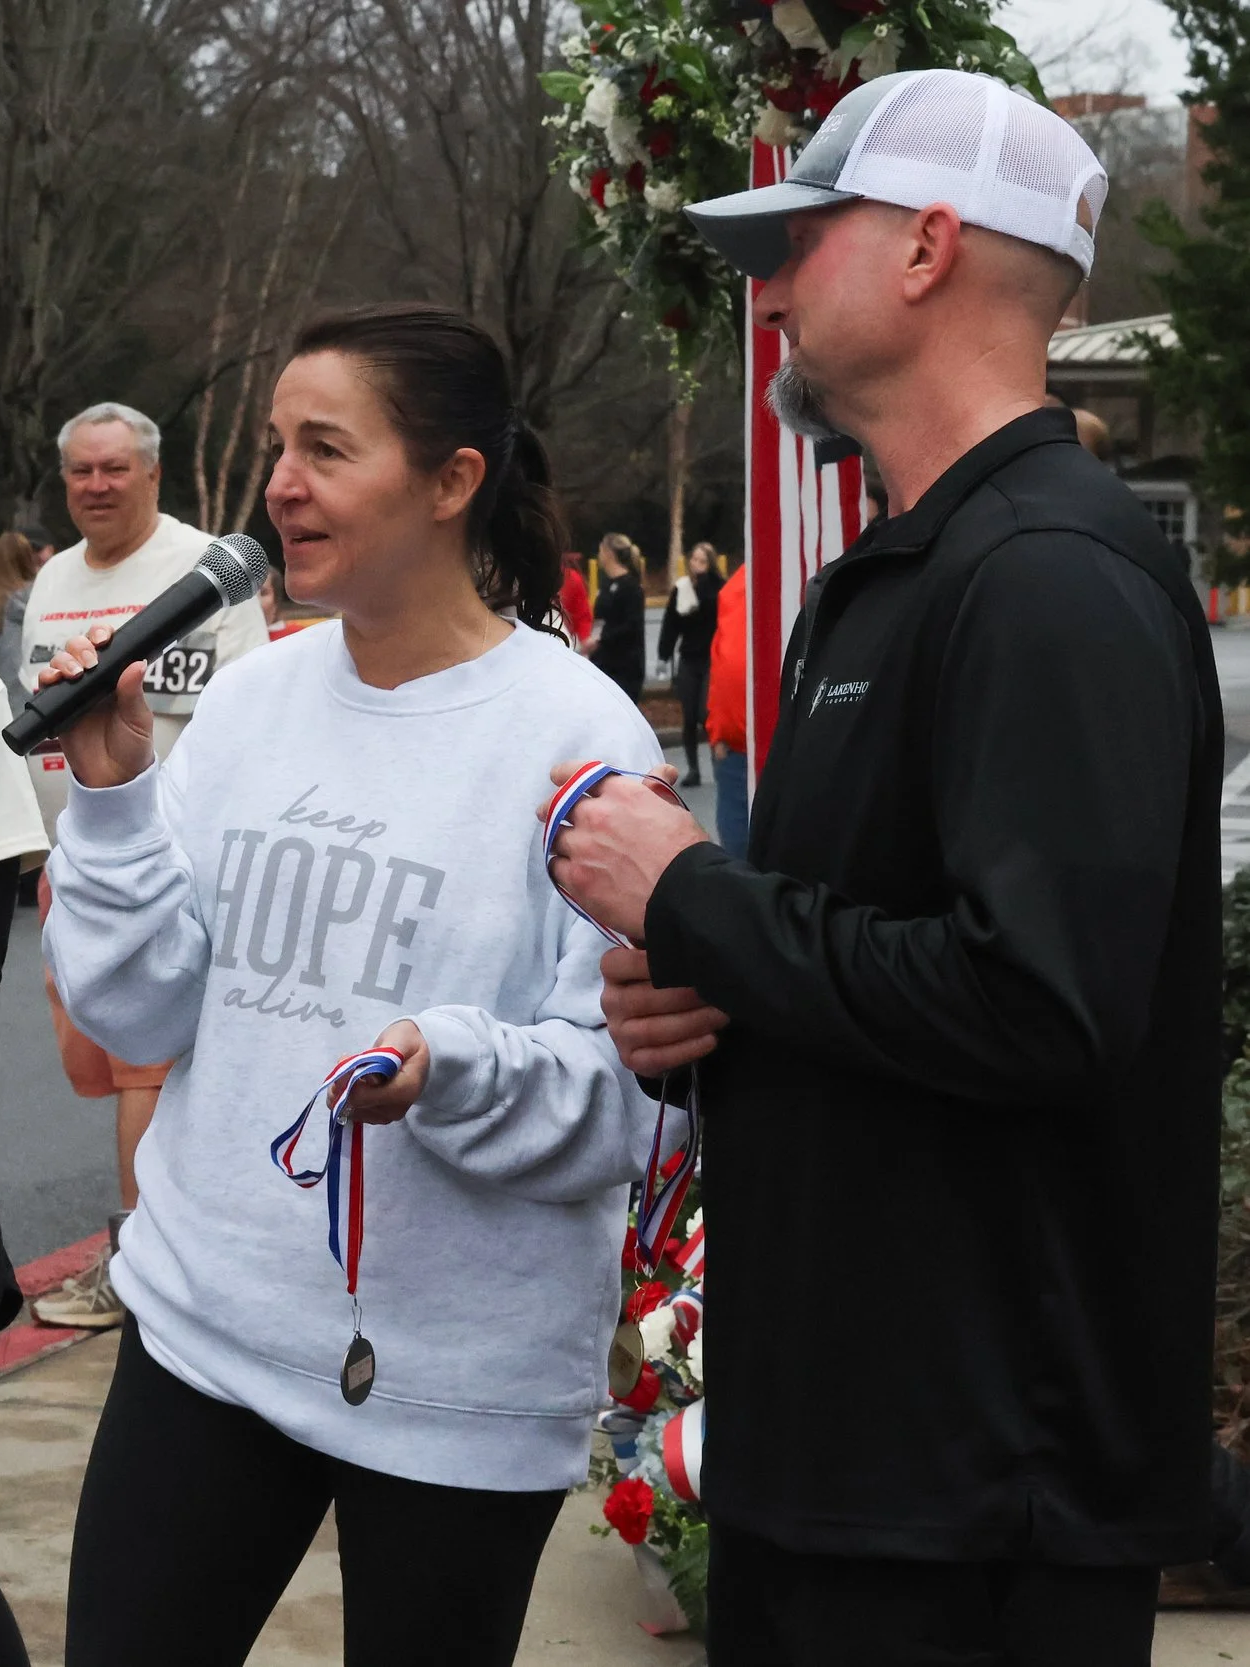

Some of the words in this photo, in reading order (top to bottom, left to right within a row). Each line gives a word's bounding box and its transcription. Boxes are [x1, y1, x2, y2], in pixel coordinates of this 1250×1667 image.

[278, 784, 387, 849] keep
[214, 829, 446, 1006] HOPE
[223, 974, 346, 1028] alive
